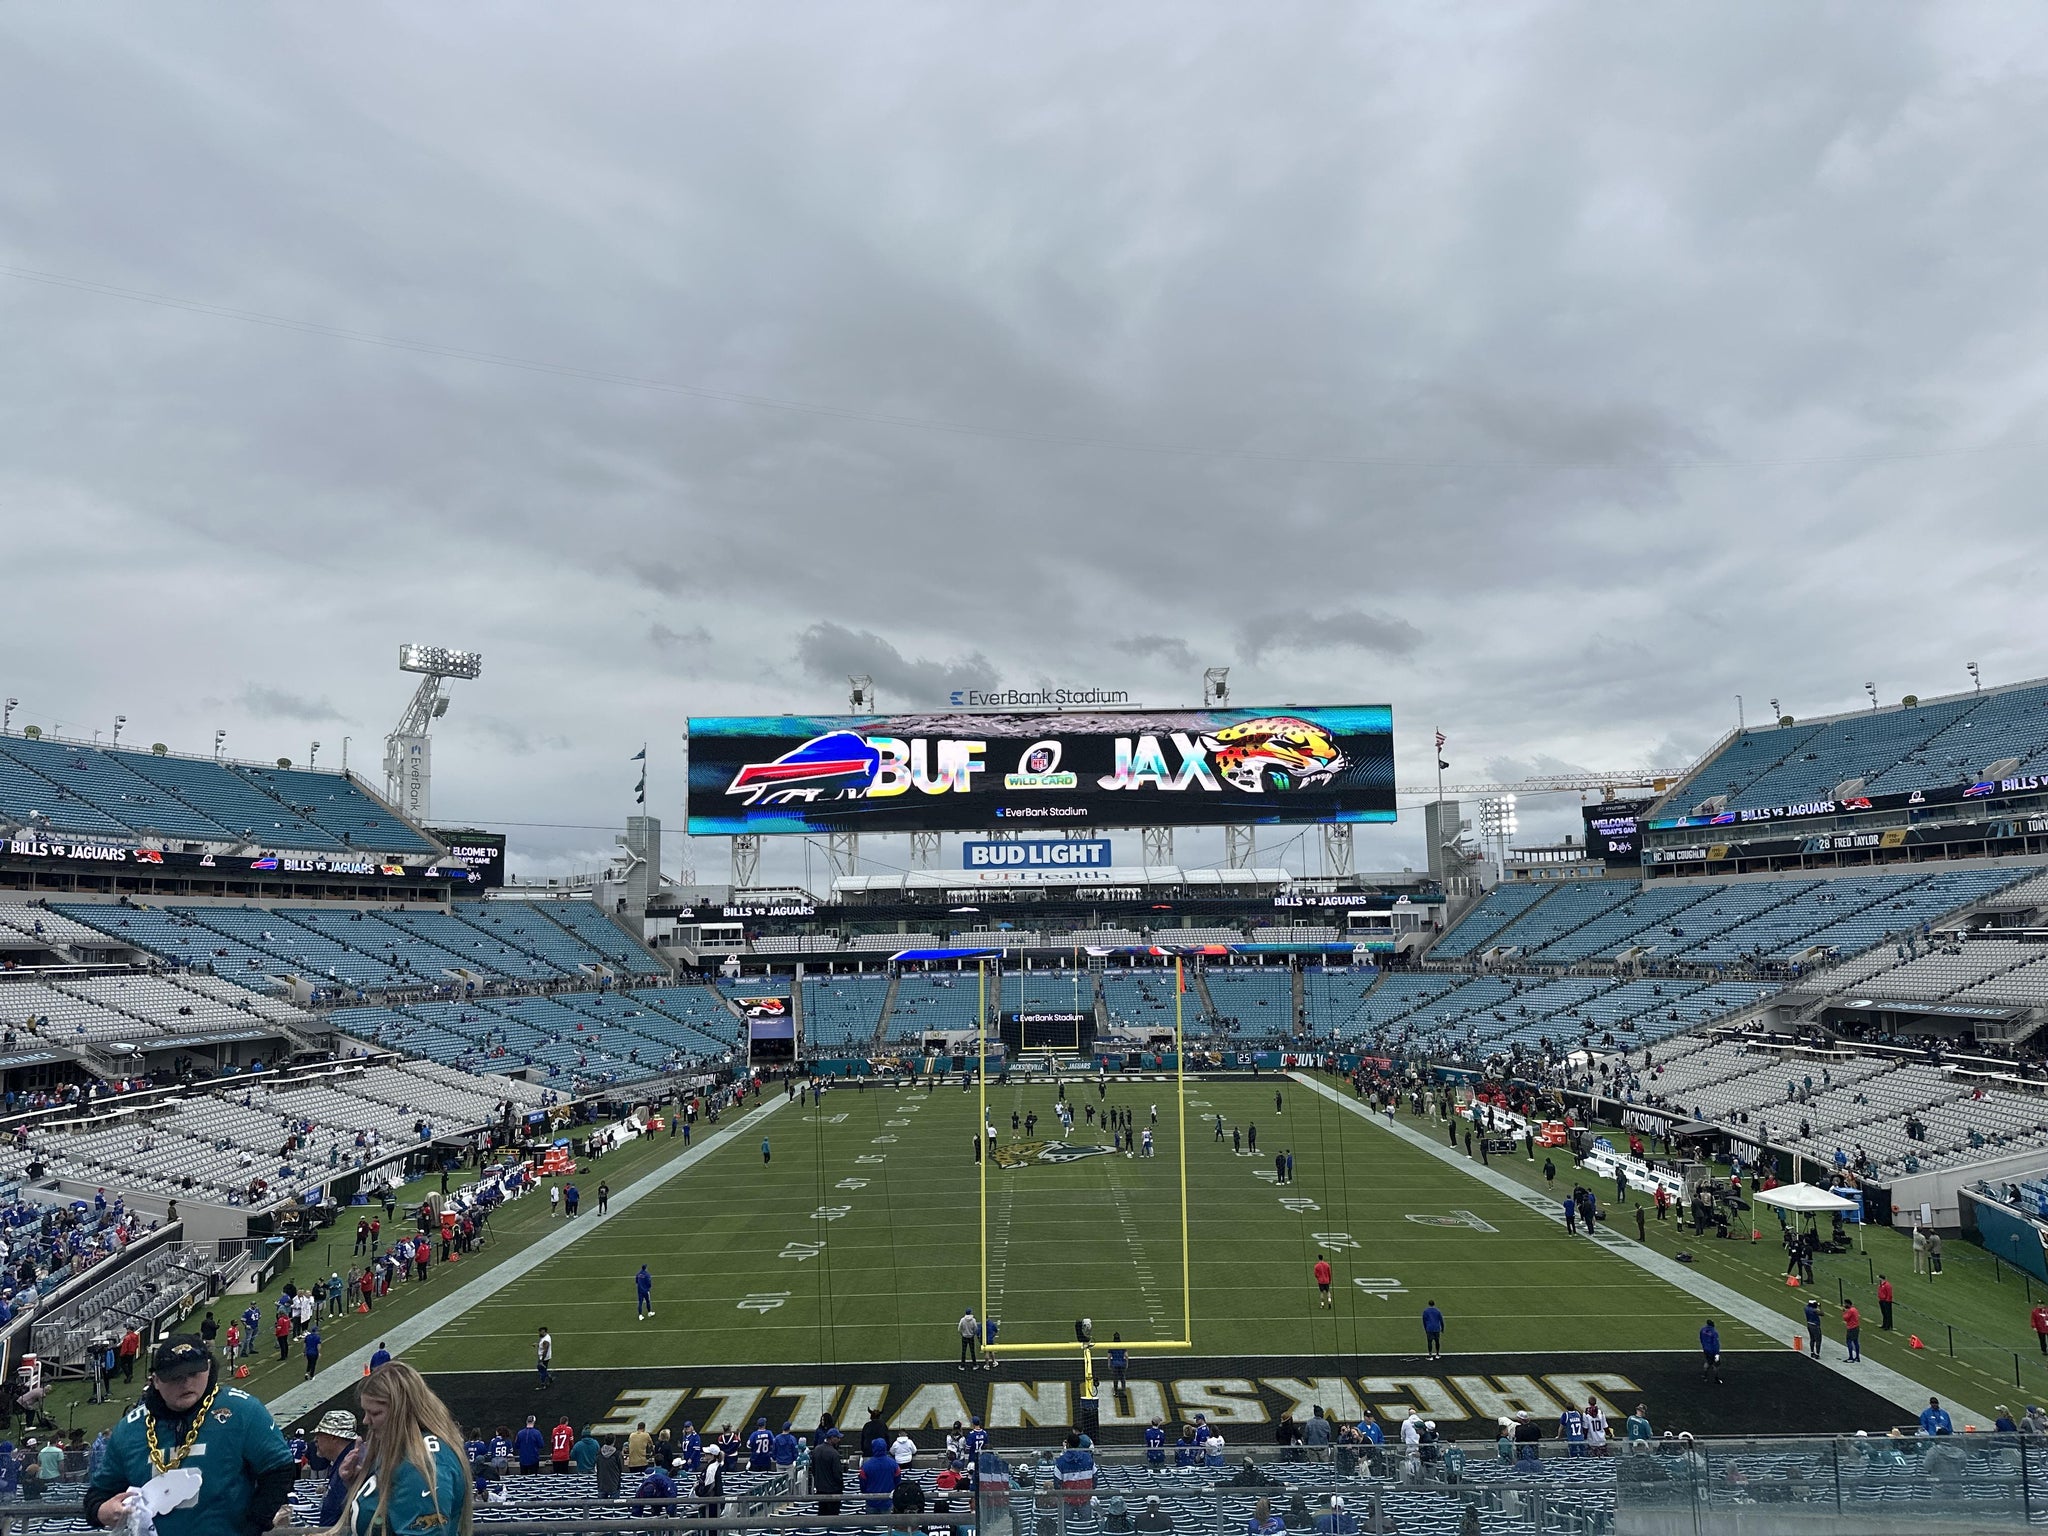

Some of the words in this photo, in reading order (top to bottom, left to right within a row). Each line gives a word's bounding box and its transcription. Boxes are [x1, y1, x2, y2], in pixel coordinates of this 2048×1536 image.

[969, 688, 1051, 706] EverBank
[1055, 688, 1128, 704] Stadium
[866, 737, 987, 797] BUF
[1097, 733, 1222, 791] JAX
[411, 757, 421, 811] EverBank
[1008, 777, 1037, 786] WILD
[1041, 776, 1073, 786] CARD
[2001, 776, 2038, 792] BILLS
[1005, 807, 1049, 817] EverBank
[1050, 806, 1088, 816] Stadium
[1741, 808, 1771, 822] BILLS
[1786, 801, 1836, 817] JAGUARS
[1591, 816, 1634, 829] WELCOME
[2027, 819, 2048, 832] TONY
[1623, 826, 1637, 834] GAM
[1819, 839, 1831, 850] 28
[1834, 837, 1852, 849] FRED
[1854, 834, 1880, 847] TAYLOR
[10, 841, 48, 857] BILLS
[67, 846, 126, 862] JAGUARS
[453, 847, 486, 857] ELCOME
[487, 848, 498, 857] TO
[972, 845, 1026, 865] BUD
[1029, 844, 1103, 864] LIGHT
[1663, 851, 1676, 861] TOM
[1677, 848, 1707, 860] COUGHLIN
[284, 858, 314, 871] BILLS
[328, 861, 375, 875] JAGUARS
[1274, 896, 1303, 907] BILLS
[1318, 895, 1367, 906] JAGUARS
[723, 907, 752, 917] BILLS
[768, 906, 815, 917] JAGUARS
[1939, 1005, 2011, 1016] INSURANCE
[1019, 1014, 1053, 1022] EverBank
[1054, 1013, 1084, 1021] Stadium
[1239, 1053, 1250, 1063] 25
[1068, 1062, 1091, 1070] JAGUARS
[1278, 1198, 1321, 1210] 30
[809, 1205, 852, 1218] 30
[1311, 1232, 1362, 1248] 20
[778, 1241, 827, 1258] 20
[1353, 1277, 1409, 1293] 10
[736, 1291, 792, 1309] 10
[590, 1373, 1642, 1436] JACKSONVILLE
[1571, 1423, 1582, 1436] 17
[1591, 1420, 1601, 1432] 10
[1633, 1424, 1639, 1436] 8
[554, 1434, 567, 1450] 17
[755, 1438, 769, 1453] 78
[975, 1440, 984, 1450] 17
[1150, 1439, 1160, 1448] 17
[468, 1452, 475, 1462] 3
[495, 1446, 507, 1457] 58
